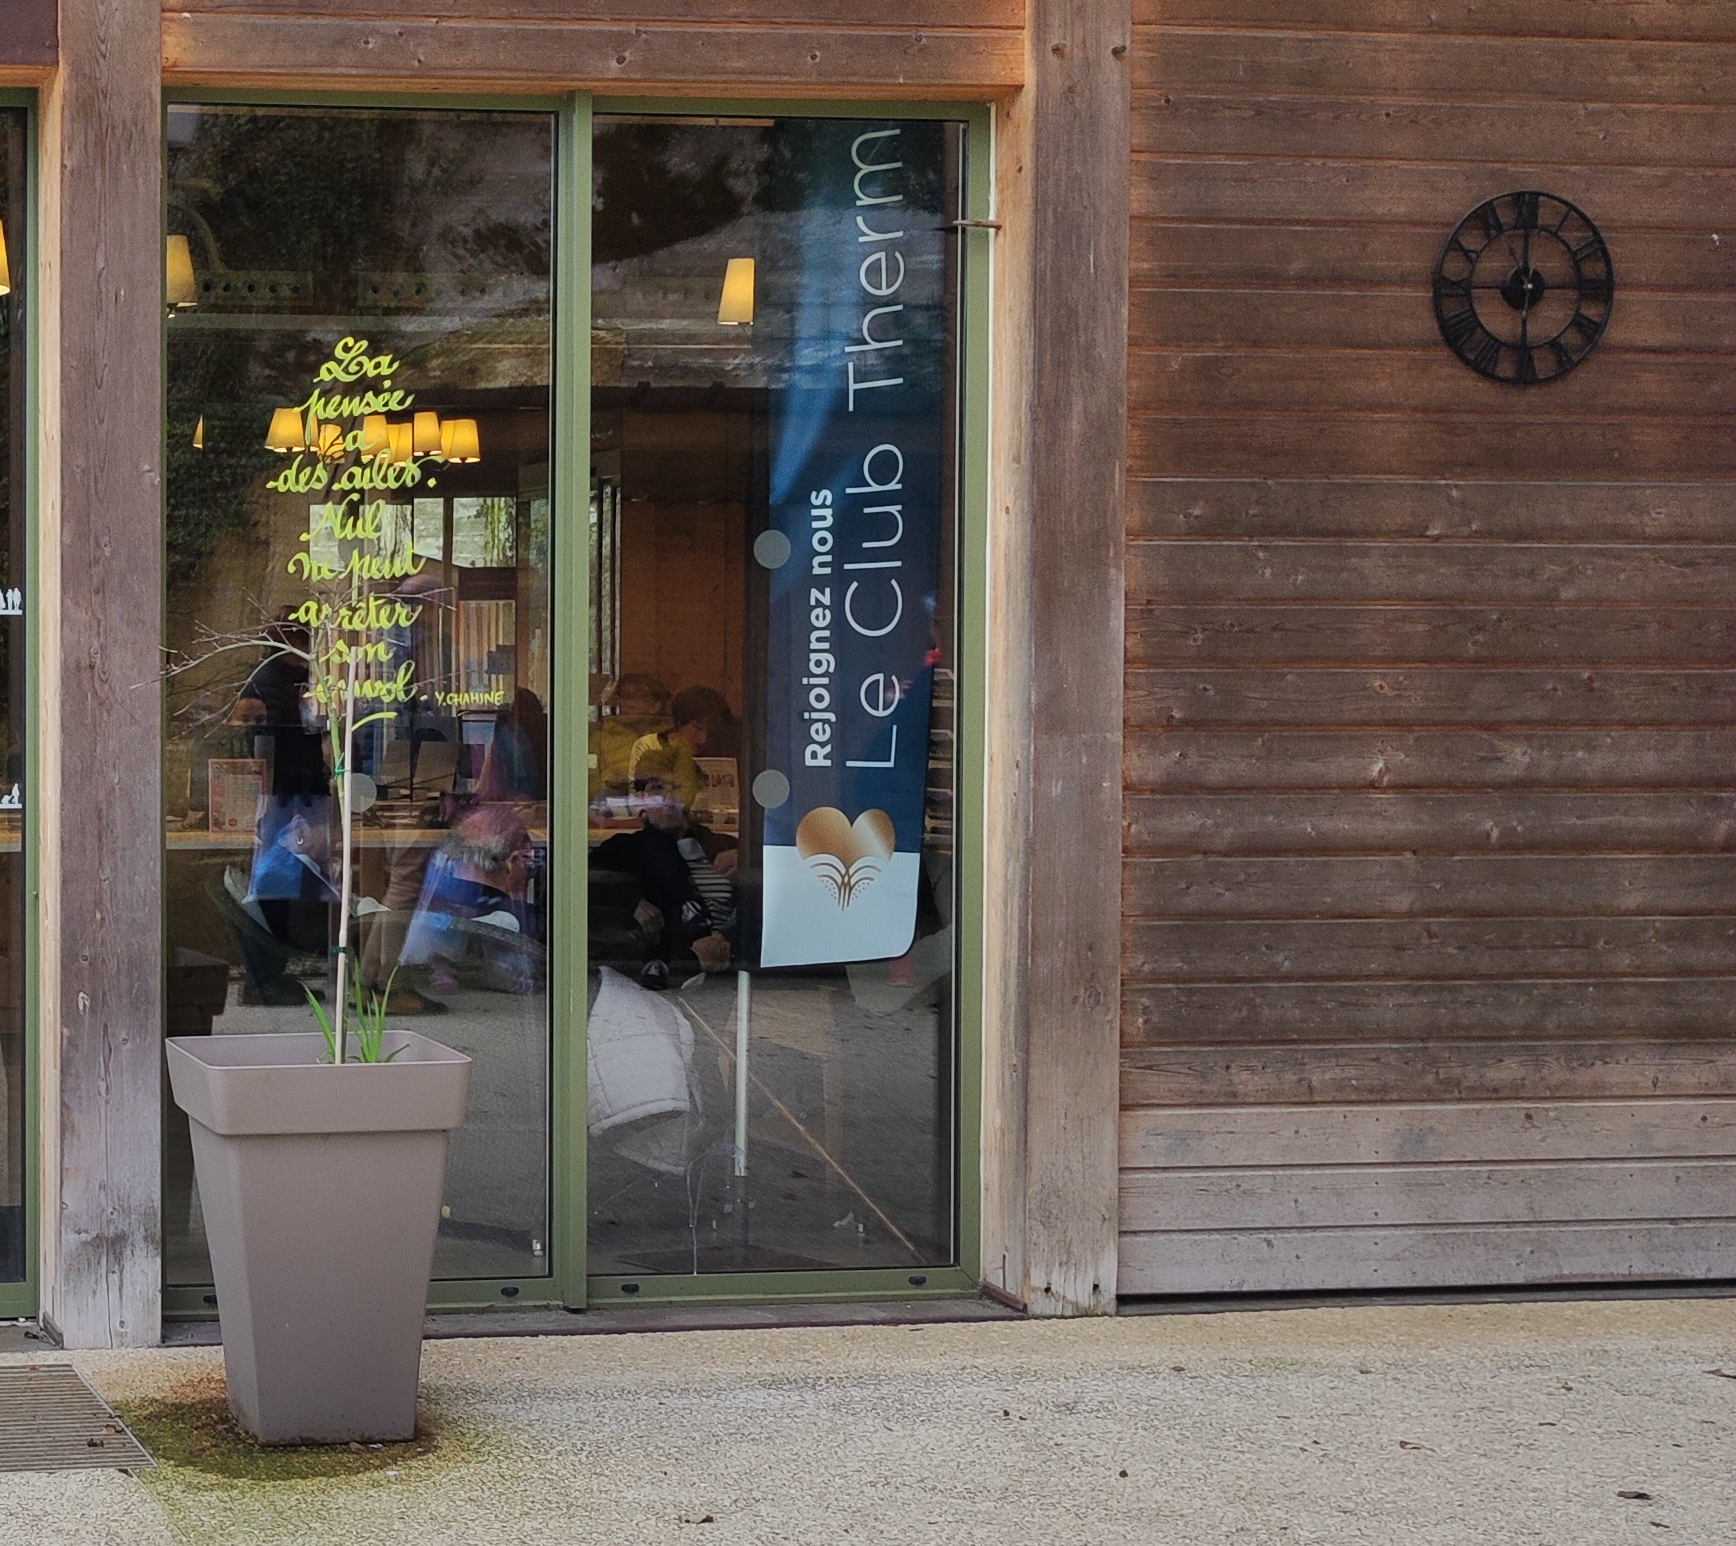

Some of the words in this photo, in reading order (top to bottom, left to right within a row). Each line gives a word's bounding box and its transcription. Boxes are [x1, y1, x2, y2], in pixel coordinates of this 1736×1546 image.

[312, 336, 401, 383] La
[292, 379, 416, 446] pensée
[265, 454, 329, 494] des
[298, 493, 386, 541] Nul
[810, 487, 834, 576] nous
[843, 442, 905, 638] Club
[287, 551, 341, 583] ne
[337, 538, 428, 608] peut
[287, 591, 424, 631] arrêter
[318, 638, 397, 665] son
[802, 586, 837, 768] Rejoignez
[844, 671, 901, 769] Le
